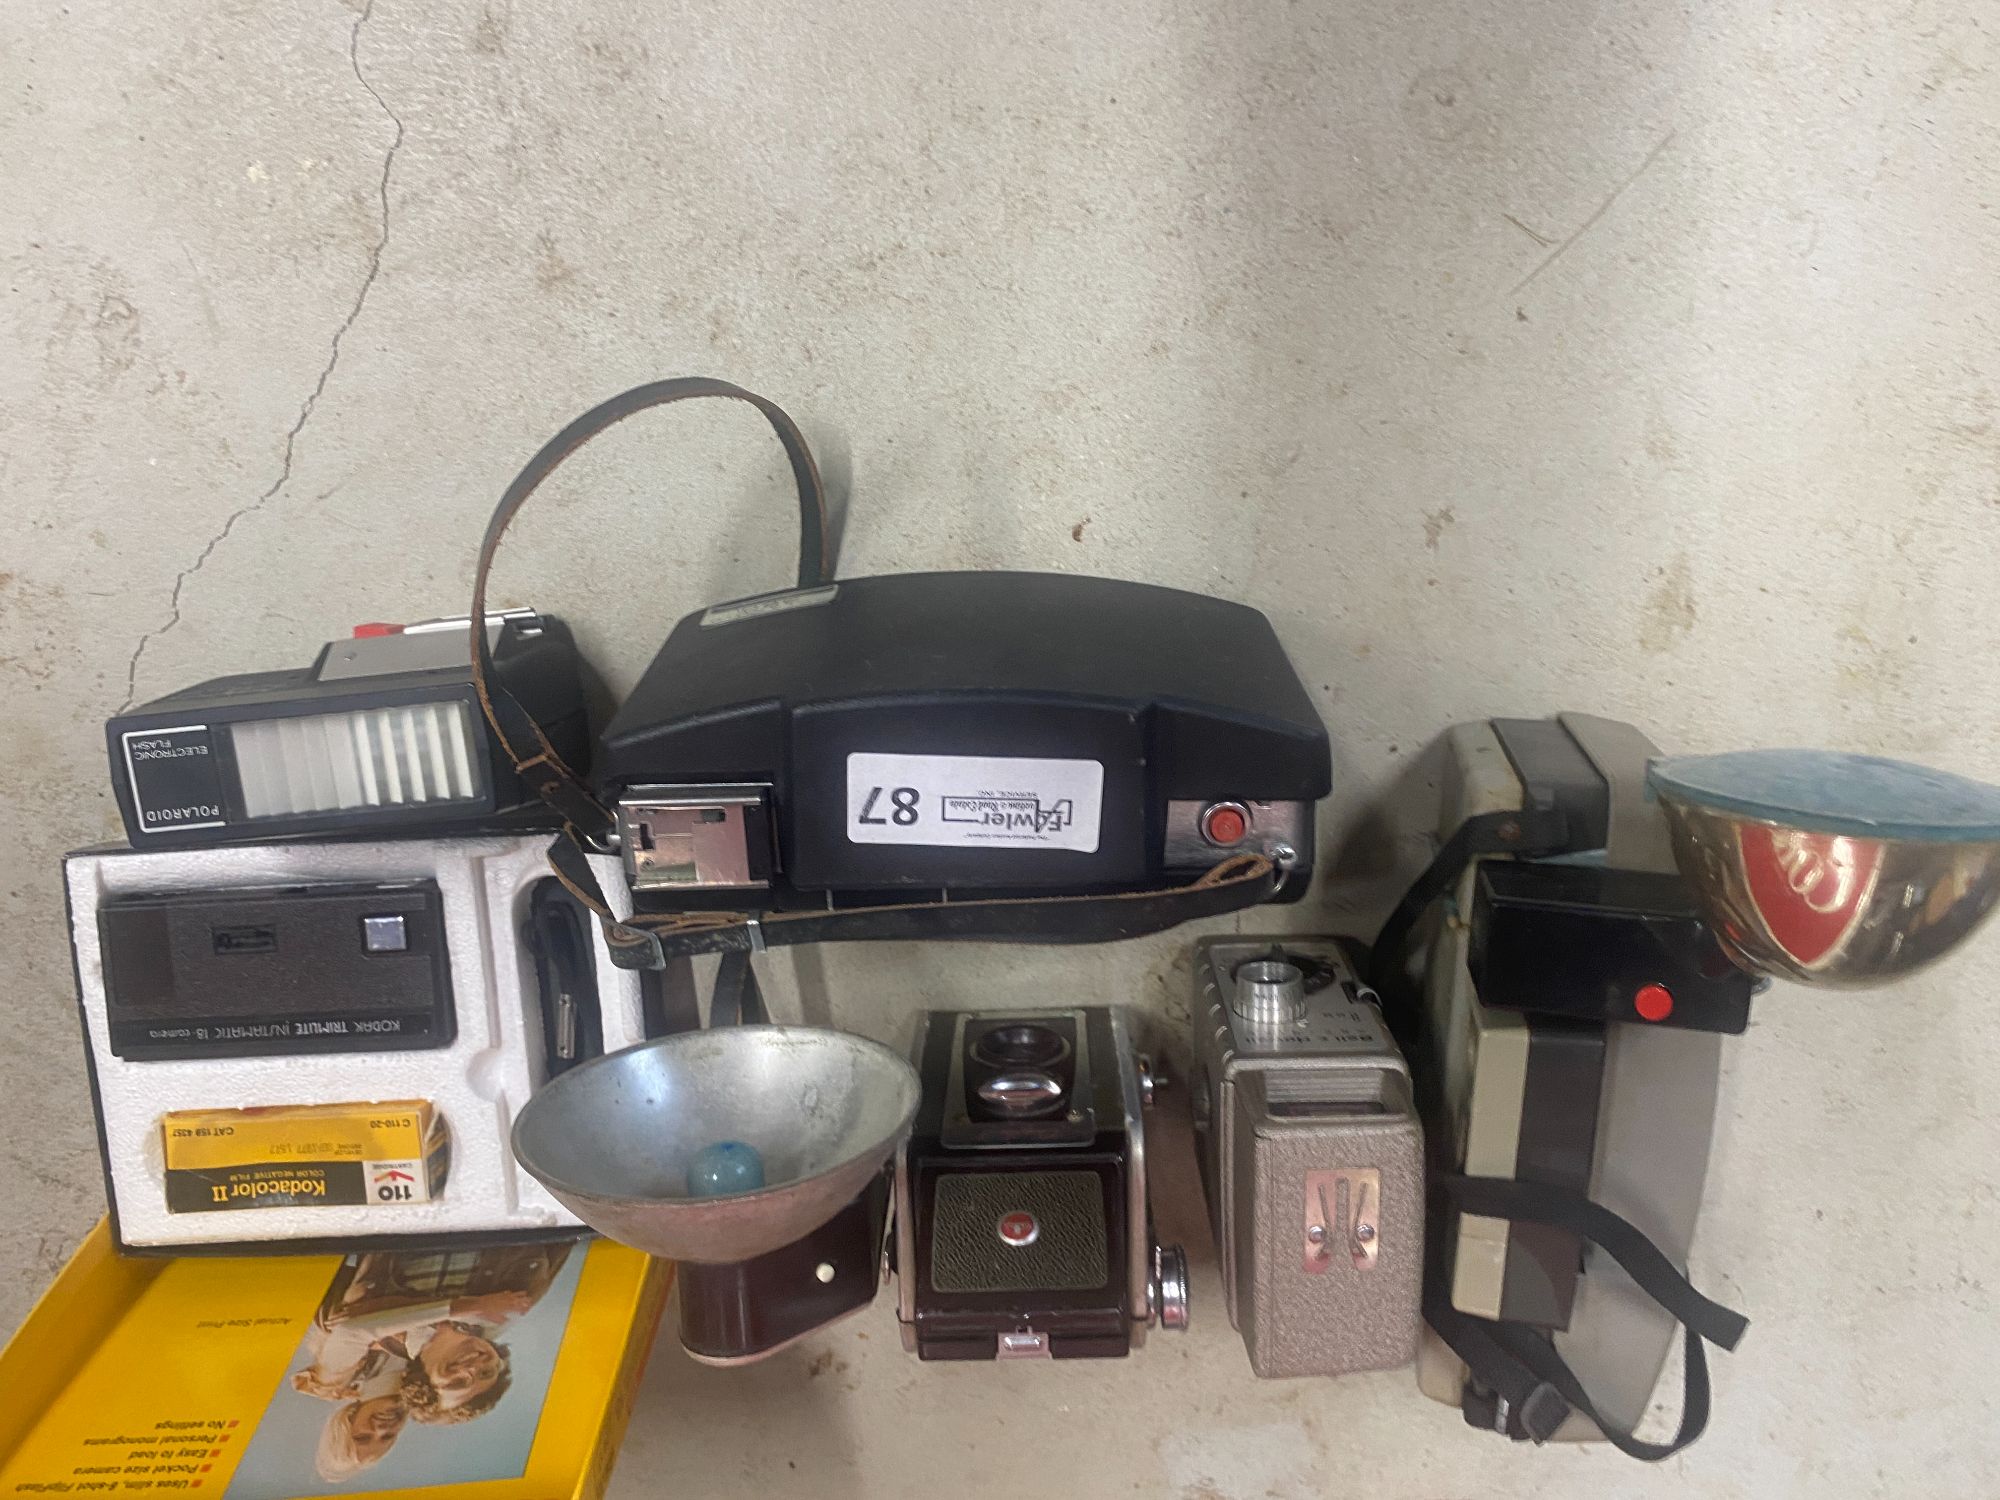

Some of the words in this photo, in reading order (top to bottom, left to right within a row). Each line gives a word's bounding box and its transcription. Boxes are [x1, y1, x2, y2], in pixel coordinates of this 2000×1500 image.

[132, 740, 171, 749] FLASH
[134, 746, 208, 760] ELECTRONIC
[859, 787, 920, 826] 87
[147, 805, 219, 821] POLAROID
[215, 1023, 290, 1038] INSTAMATIC
[294, 1021, 349, 1035] TRIMLITE
[353, 1019, 400, 1033] KODAK
[149, 1028, 191, 1038] camera
[196, 1028, 209, 1039] 18
[370, 1119, 400, 1129] 110-20
[401, 1119, 411, 1127] C
[213, 1126, 234, 1136] CAT
[229, 1173, 250, 1182] FILM
[254, 1170, 294, 1180] NEGATIVE
[296, 1169, 324, 1178] COLOR
[212, 1185, 228, 1201] II
[231, 1180, 326, 1198] Kodacolor
[379, 1185, 412, 1201] 110
[155, 1419, 204, 1431] settings
[208, 1420, 226, 1429] No
[83, 1435, 158, 1447] monograms
[160, 1434, 218, 1446] Personal
[128, 1450, 158, 1460] load
[160, 1449, 175, 1460] to
[177, 1448, 209, 1460] Easy
[73, 1466, 122, 1477] camera
[123, 1466, 150, 1476] size
[152, 1464, 199, 1476] Pocket
[122, 1479, 152, 1490] slim,
[156, 1479, 189, 1489] Uses
